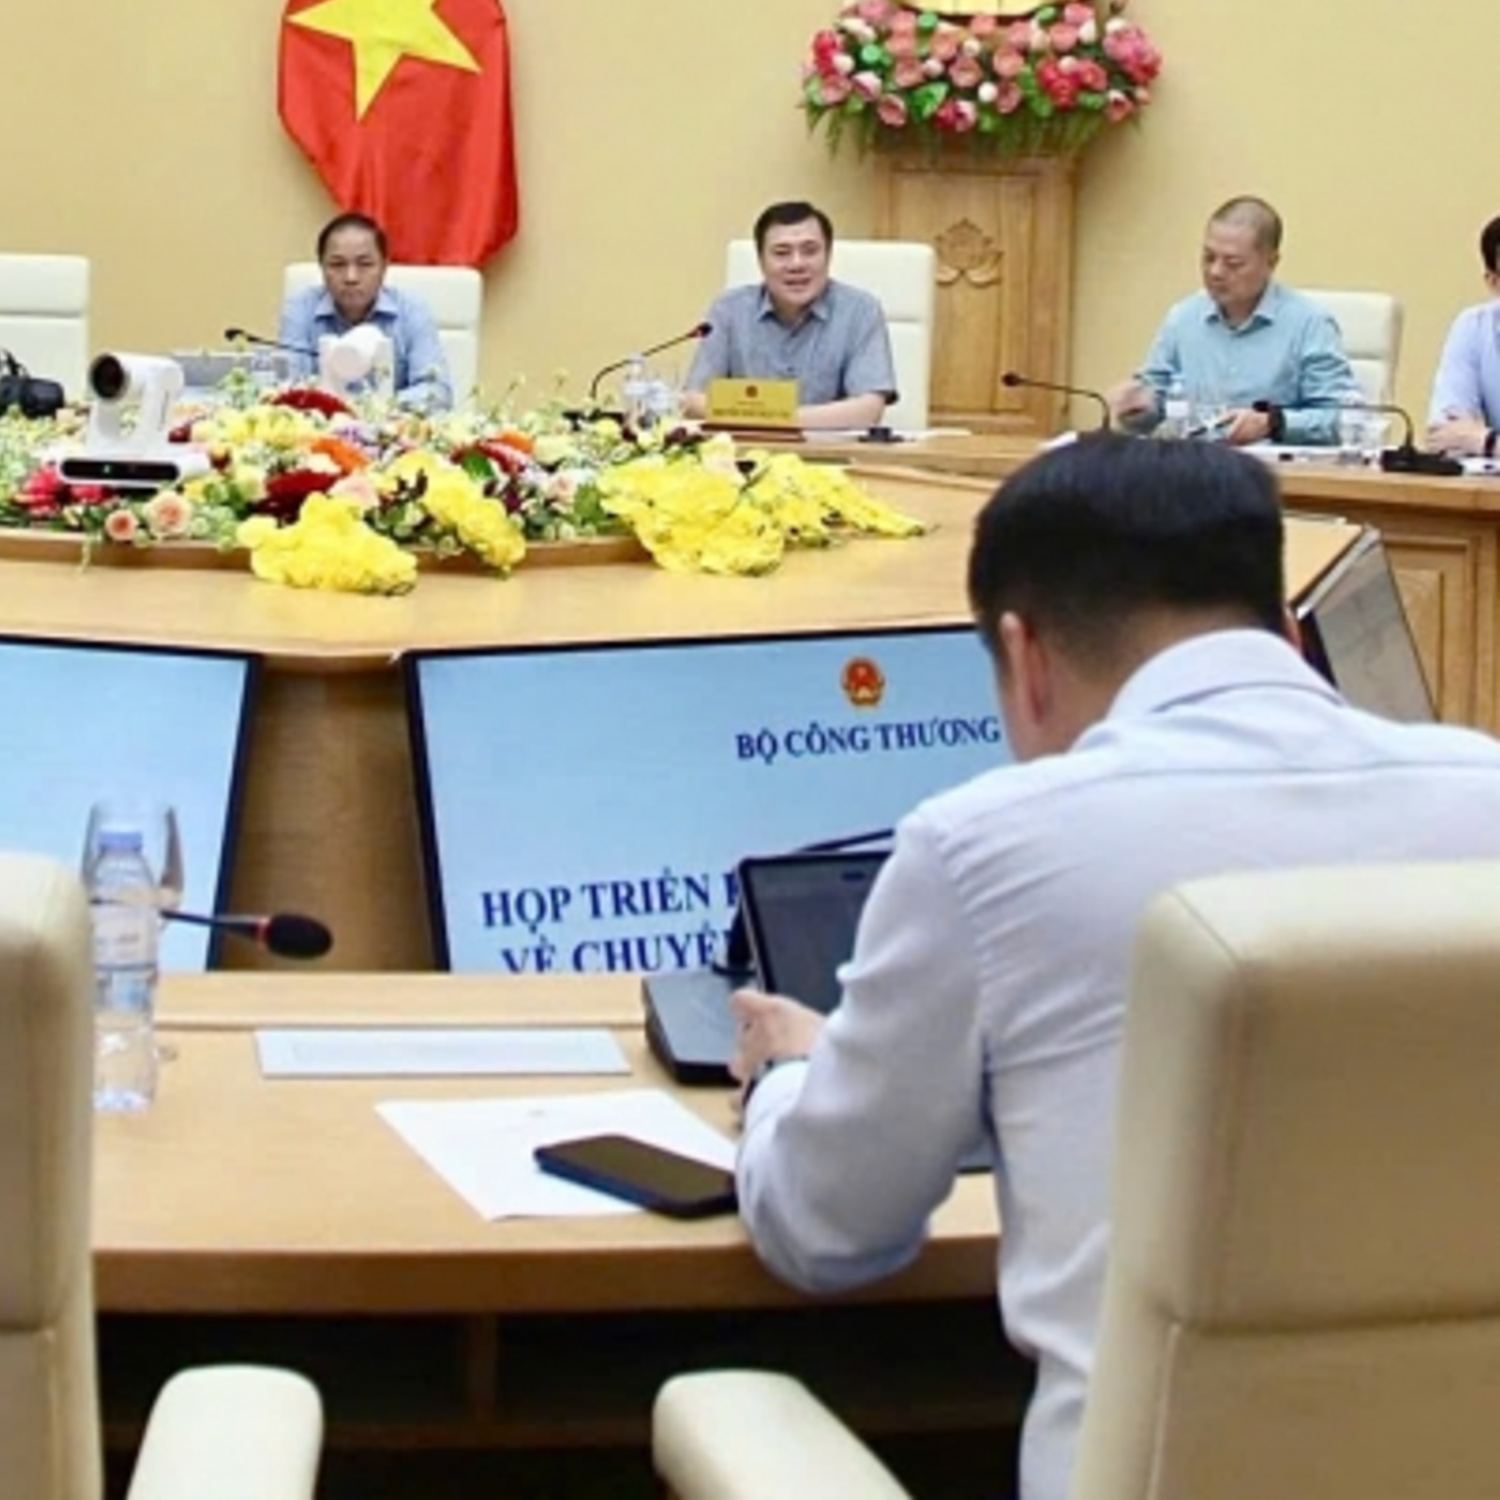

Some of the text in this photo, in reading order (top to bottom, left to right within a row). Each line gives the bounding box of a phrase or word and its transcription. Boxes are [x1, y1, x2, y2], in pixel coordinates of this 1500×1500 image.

[735, 715, 1000, 766] BỘ CÔNG THƯƠNG
[482, 886, 573, 935] HỌP
